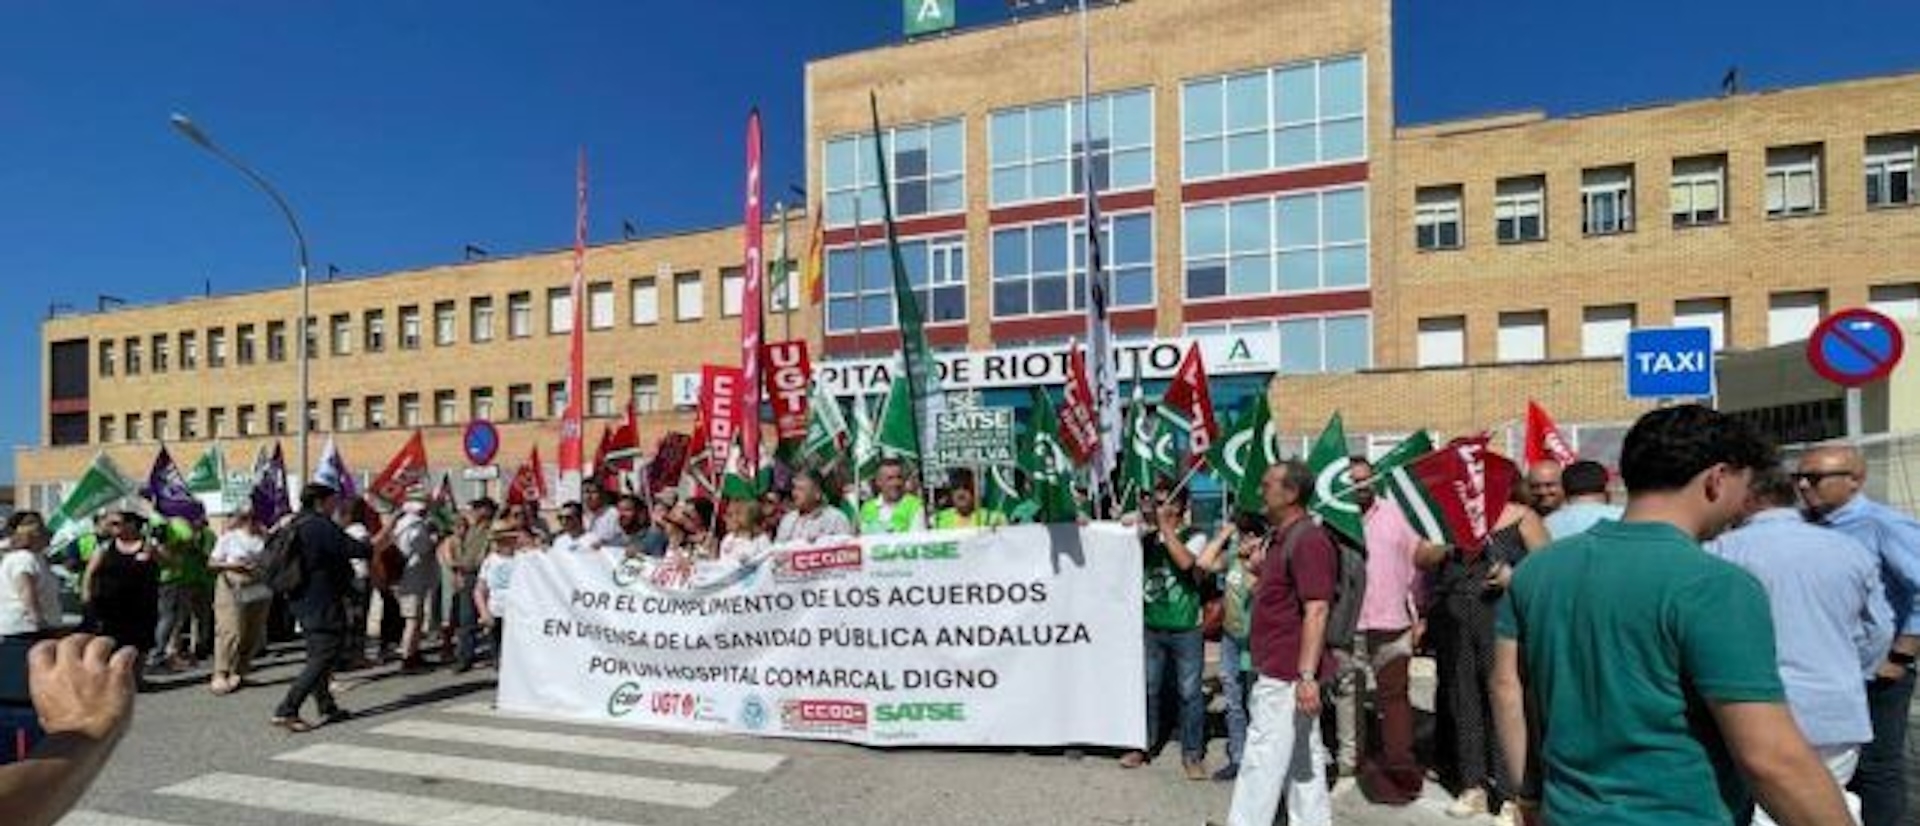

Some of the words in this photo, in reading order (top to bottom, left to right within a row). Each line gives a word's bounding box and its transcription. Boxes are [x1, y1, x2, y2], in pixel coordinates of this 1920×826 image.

[771, 344, 805, 412] UGT
[1634, 351, 1704, 375] TAXI
[872, 541, 960, 561] SATSE
[571, 588, 610, 611] POR
[616, 594, 637, 613] EL
[802, 587, 829, 608] DE
[833, 587, 880, 608] LOS
[887, 583, 1047, 607] ACUERDOS
[544, 619, 571, 637] EN
[655, 631, 679, 649] DE
[684, 634, 712, 649] LA
[714, 627, 811, 650] SANIDAD
[818, 622, 928, 649] PÚBLICA
[936, 622, 1091, 647] ANDALUZA
[589, 655, 631, 676] POR
[664, 662, 759, 685] HOSPITAL
[765, 666, 895, 691] COMARCAL
[902, 669, 998, 689] DIGNO
[875, 702, 964, 722] SATSE
